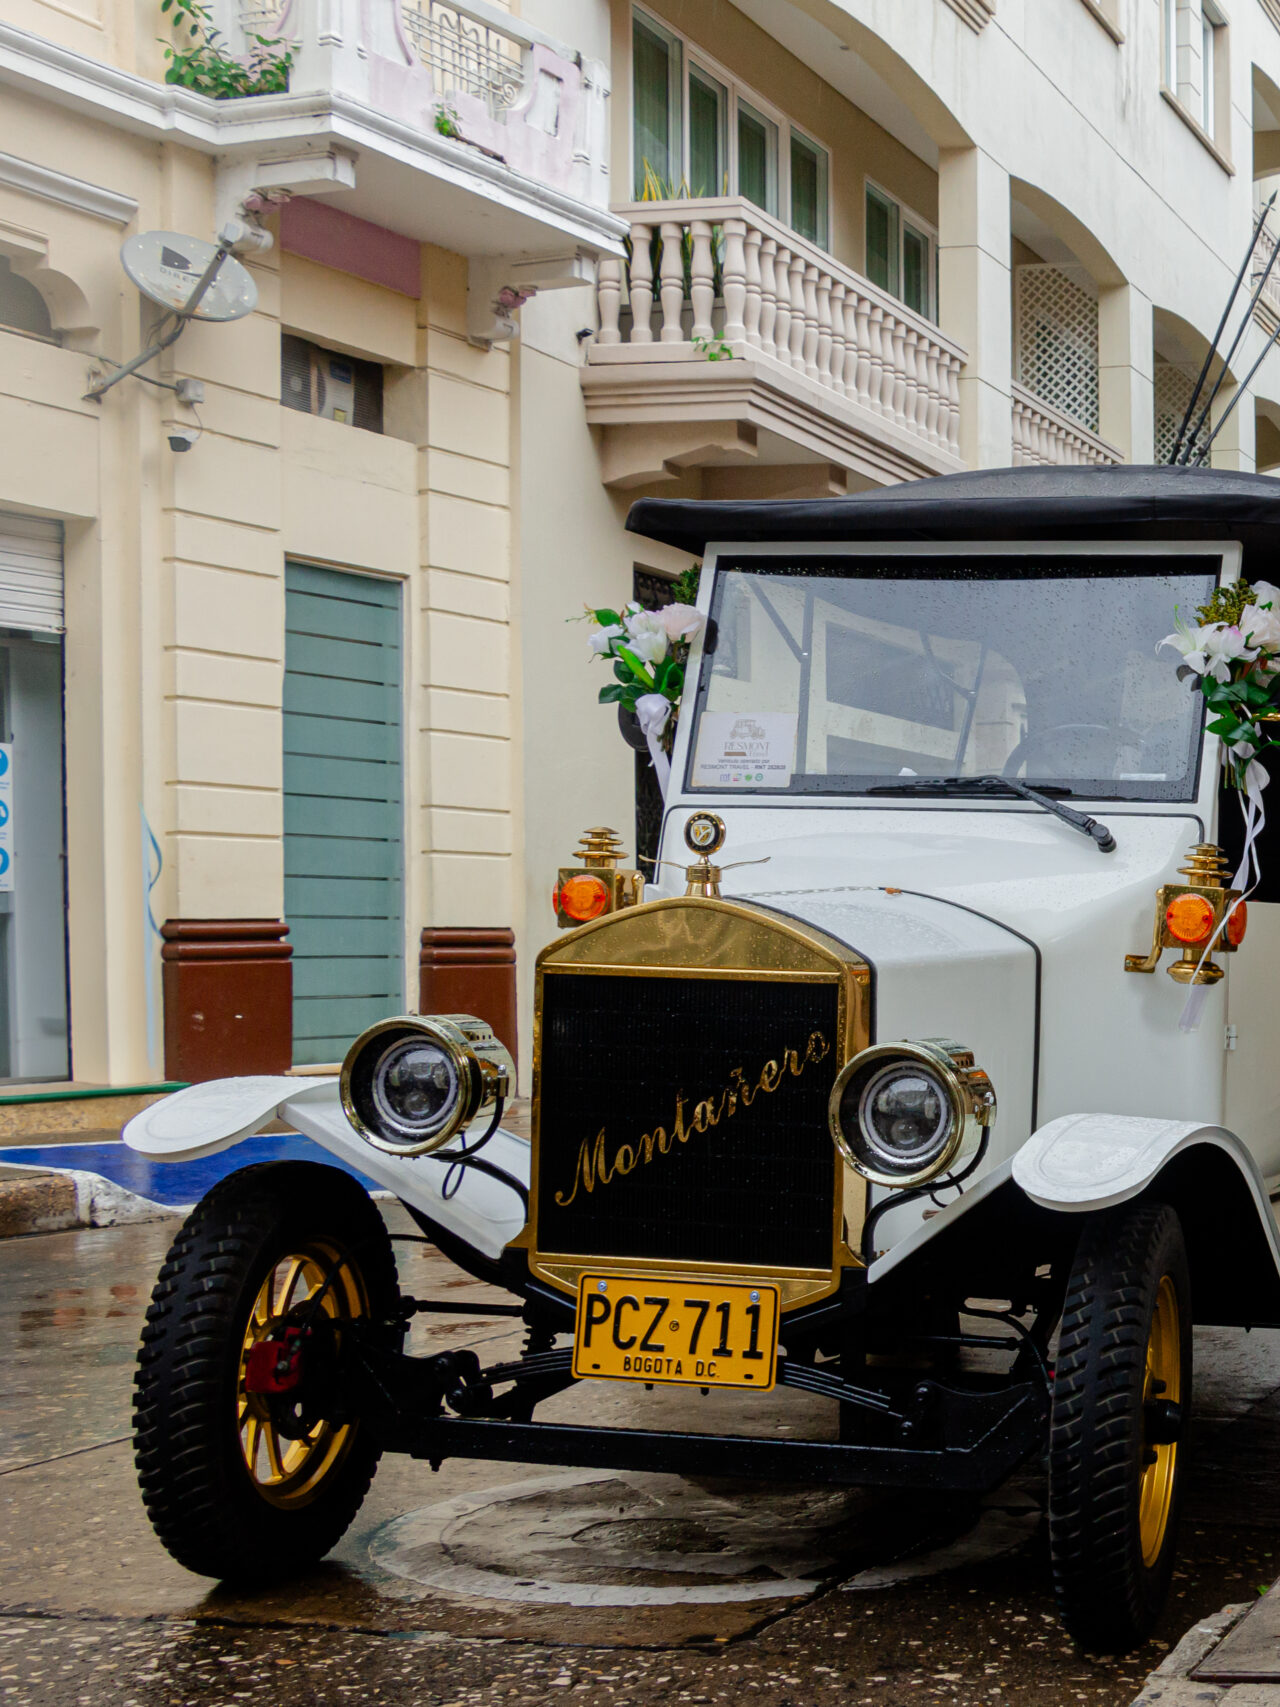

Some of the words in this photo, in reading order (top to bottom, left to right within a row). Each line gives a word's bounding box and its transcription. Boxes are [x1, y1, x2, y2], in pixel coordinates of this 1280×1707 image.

[724, 742, 769, 752] RESMONT
[555, 1031, 830, 1206] Montañero
[584, 1293, 670, 1352] PCZ
[684, 1299, 764, 1360] 711
[623, 1355, 683, 1376] BOGOTA
